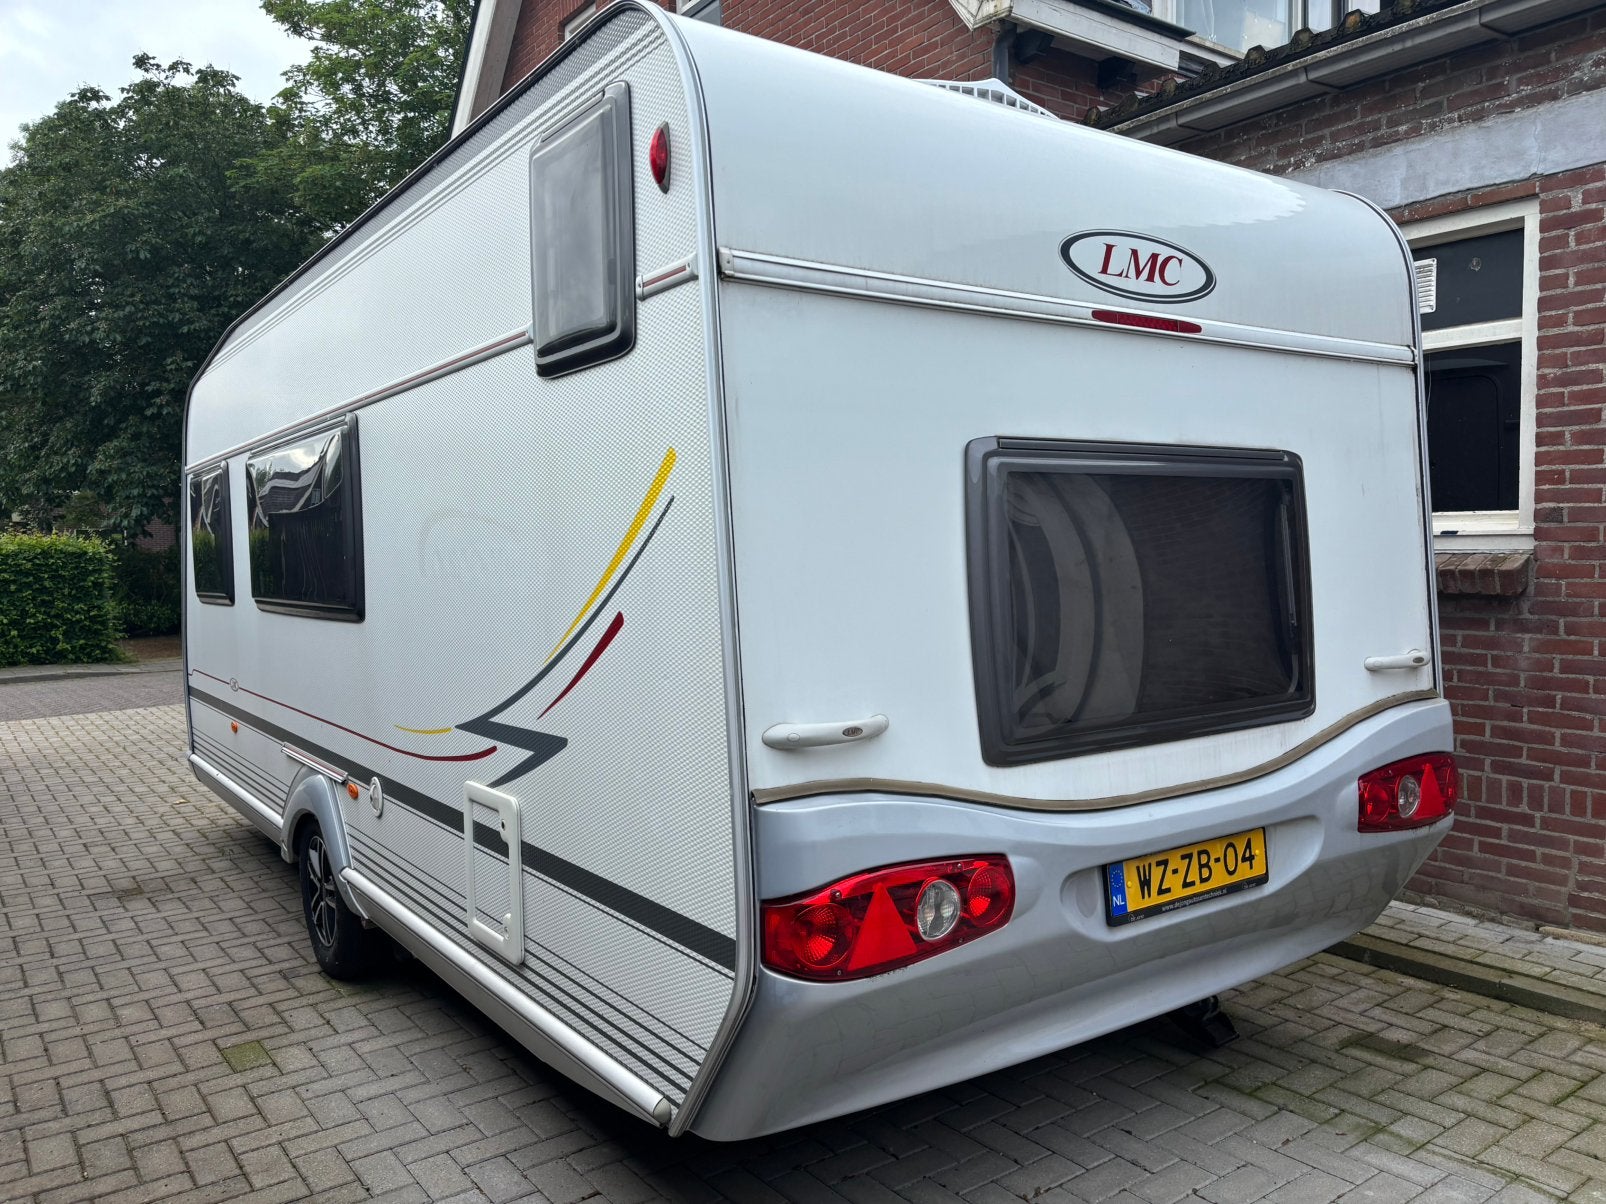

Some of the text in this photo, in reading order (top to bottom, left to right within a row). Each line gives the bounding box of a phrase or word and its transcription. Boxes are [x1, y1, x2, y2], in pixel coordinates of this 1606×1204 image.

[1097, 242, 1183, 286] LMC
[1136, 837, 1256, 900] WZ-ZB-04
[1112, 894, 1125, 907] NL
